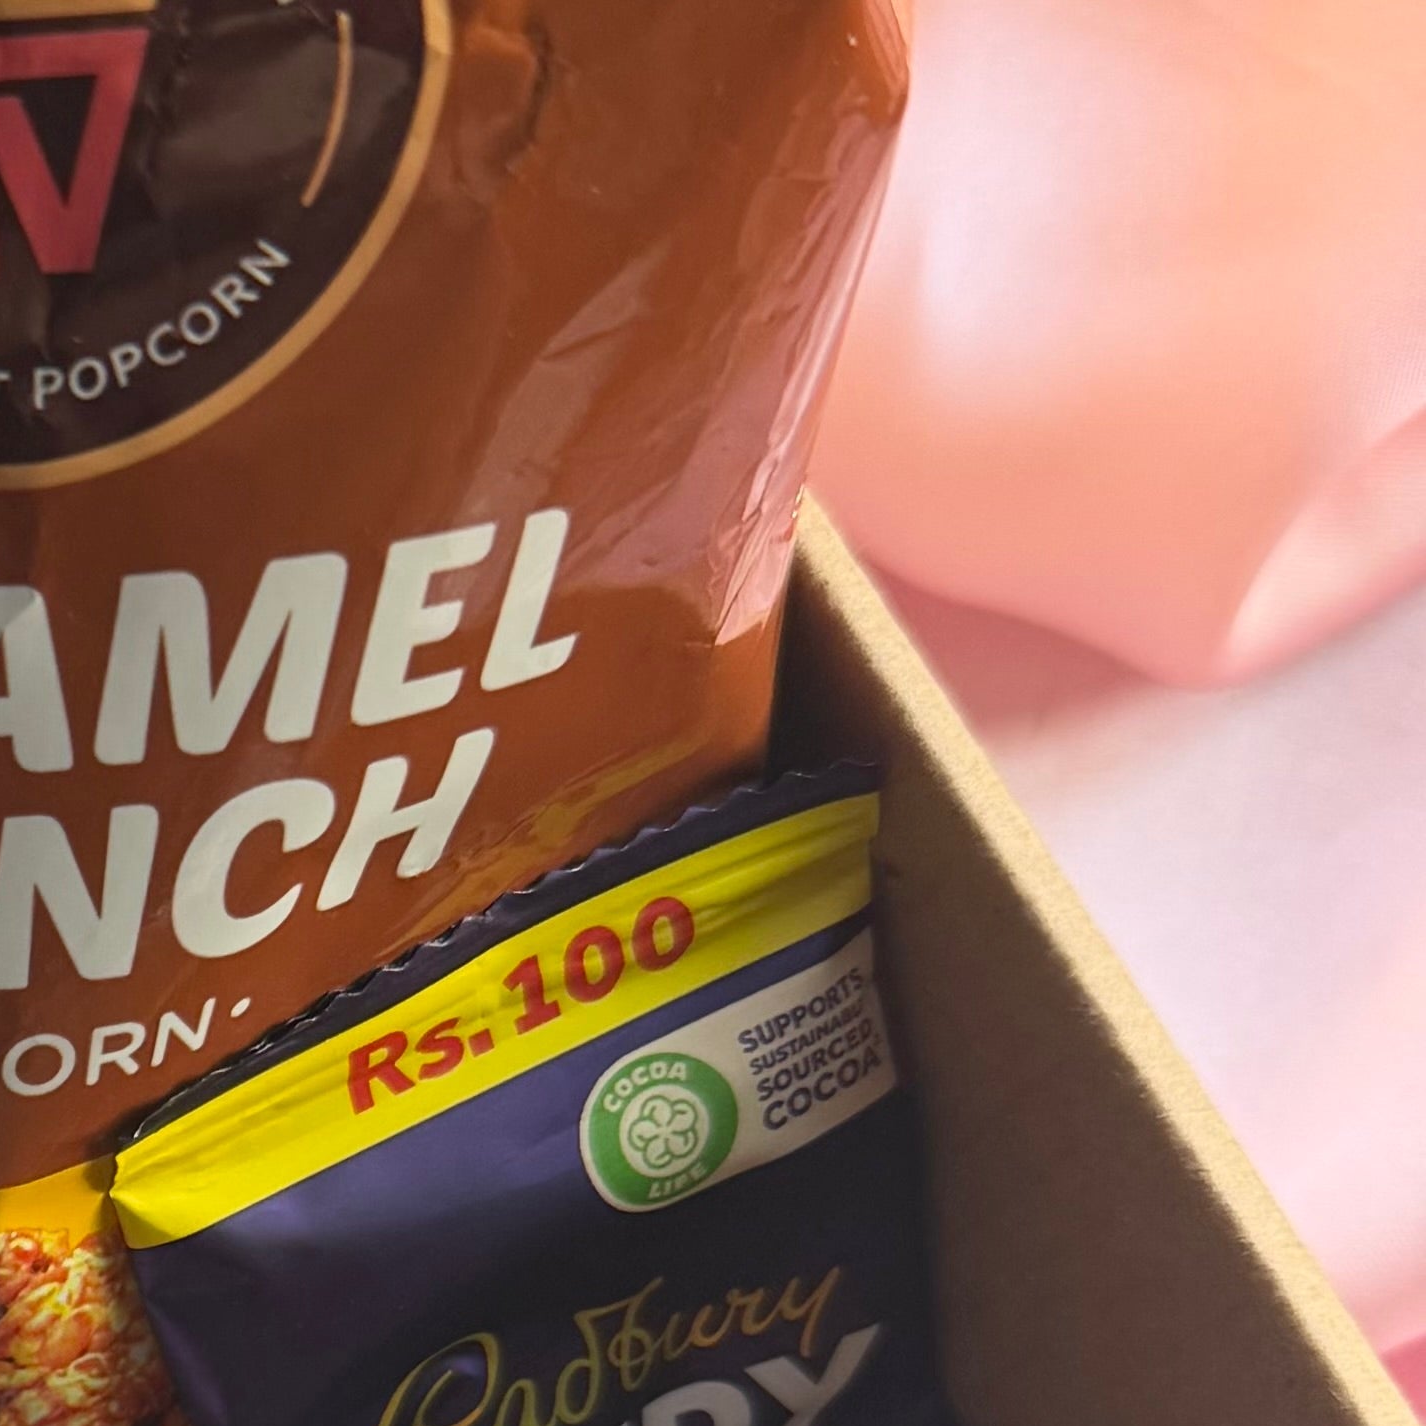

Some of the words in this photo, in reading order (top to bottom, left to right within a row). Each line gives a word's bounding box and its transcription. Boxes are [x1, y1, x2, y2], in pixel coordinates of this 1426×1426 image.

[33, 238, 292, 409] POPCORN
[348, 895, 695, 1114] Rs.100
[738, 968, 865, 1053] SUPPORTS
[603, 1061, 688, 1113] COCOA
[756, 1018, 873, 1101] SOURCED
[762, 1046, 882, 1131] COCOA
[648, 1157, 709, 1198] LIFE
